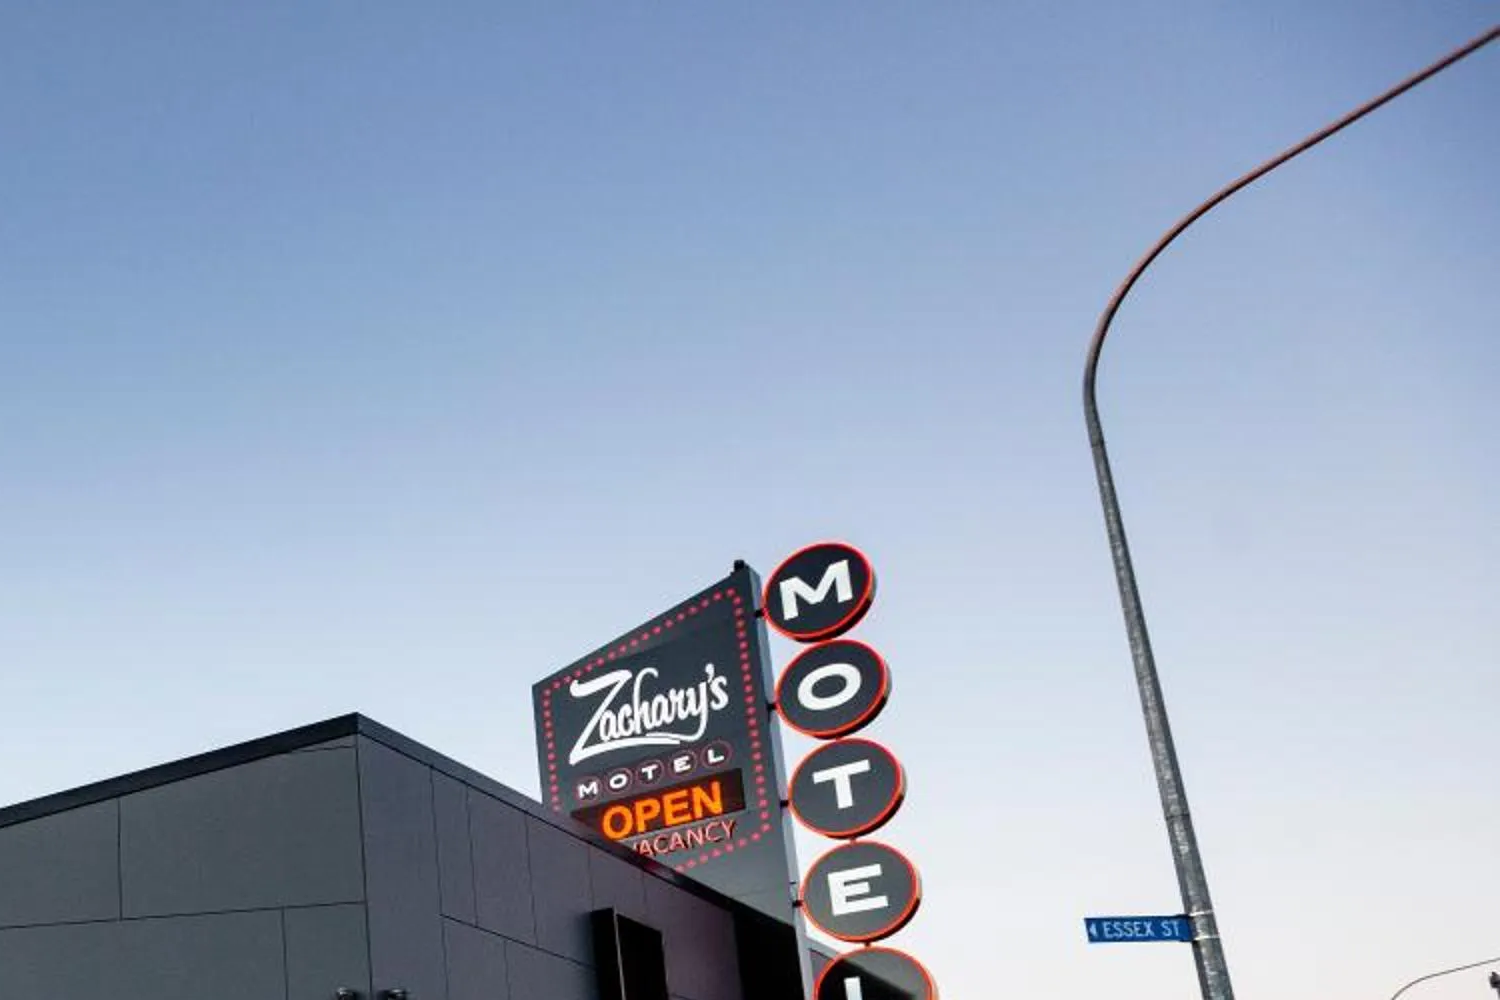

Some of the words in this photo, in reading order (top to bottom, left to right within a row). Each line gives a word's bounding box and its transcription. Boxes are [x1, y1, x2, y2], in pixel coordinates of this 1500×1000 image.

[569, 663, 729, 766] Zachary's
[577, 749, 725, 799] MOTEL
[602, 780, 723, 840] OPEN
[1102, 921, 1154, 938] ESSEX
[1161, 920, 1180, 937] ST
